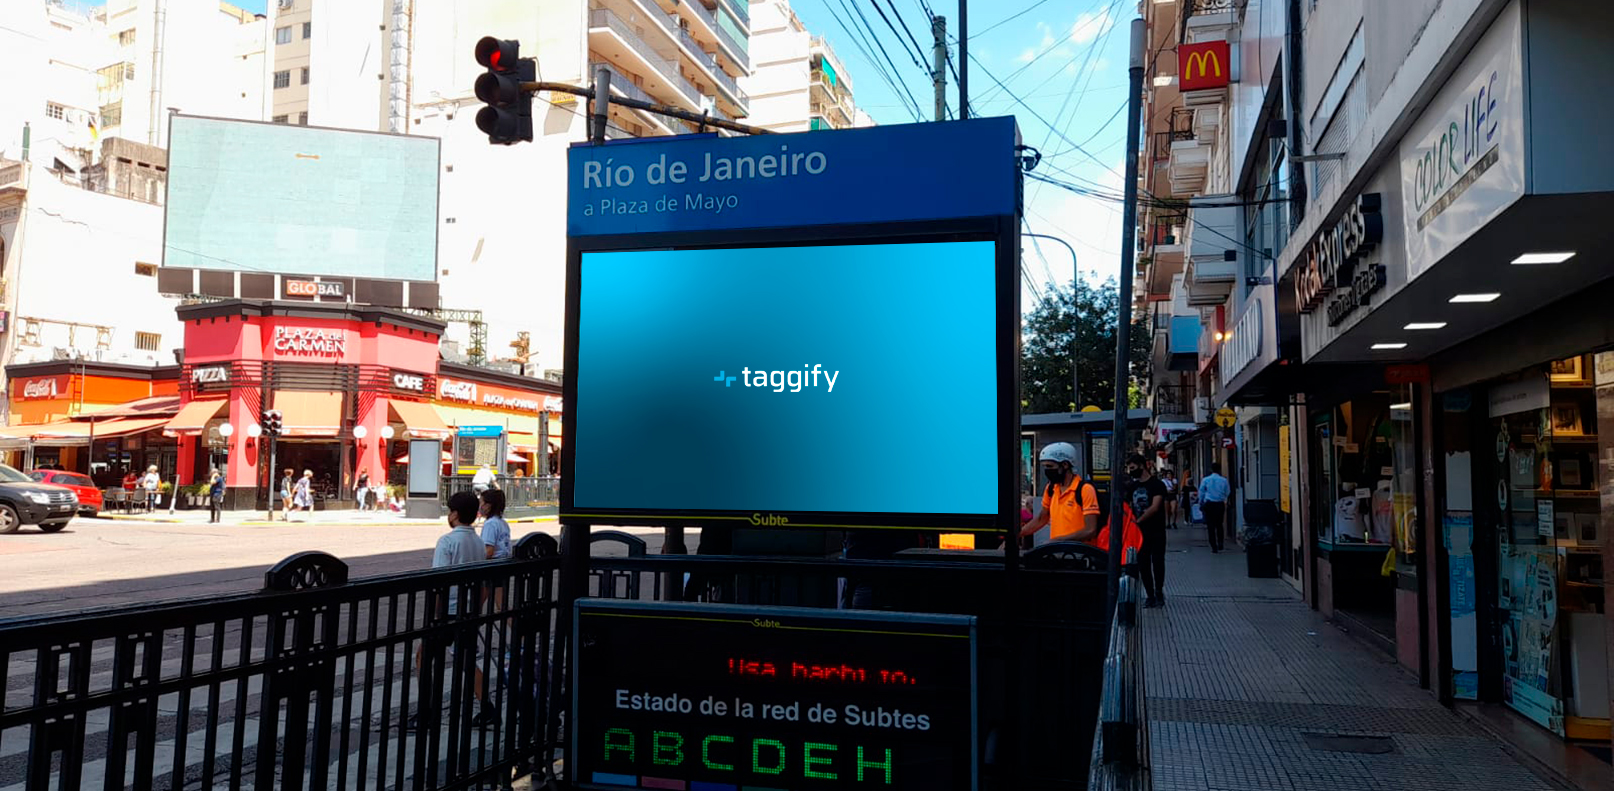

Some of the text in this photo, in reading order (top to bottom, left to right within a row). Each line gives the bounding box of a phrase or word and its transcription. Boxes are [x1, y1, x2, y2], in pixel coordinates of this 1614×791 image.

[1415, 121, 1459, 212] COLOR
[1464, 70, 1498, 165] LIFE
[583, 145, 827, 188] Río de Janeiro
[583, 193, 739, 216] a Plaza de Mayo
[1319, 193, 1366, 288] Express
[288, 282, 343, 296] GLOBAL
[275, 325, 326, 340] PLAZA
[275, 338, 346, 352] CARMEN
[192, 367, 227, 383] PIZZA
[393, 374, 424, 390] CAFE
[741, 363, 840, 393] taggify
[752, 513, 789, 526] Subte
[753, 618, 780, 629] Subte
[615, 688, 931, 731] Estado de la red de Subtes
[604, 727, 892, 784] A B C D E H
